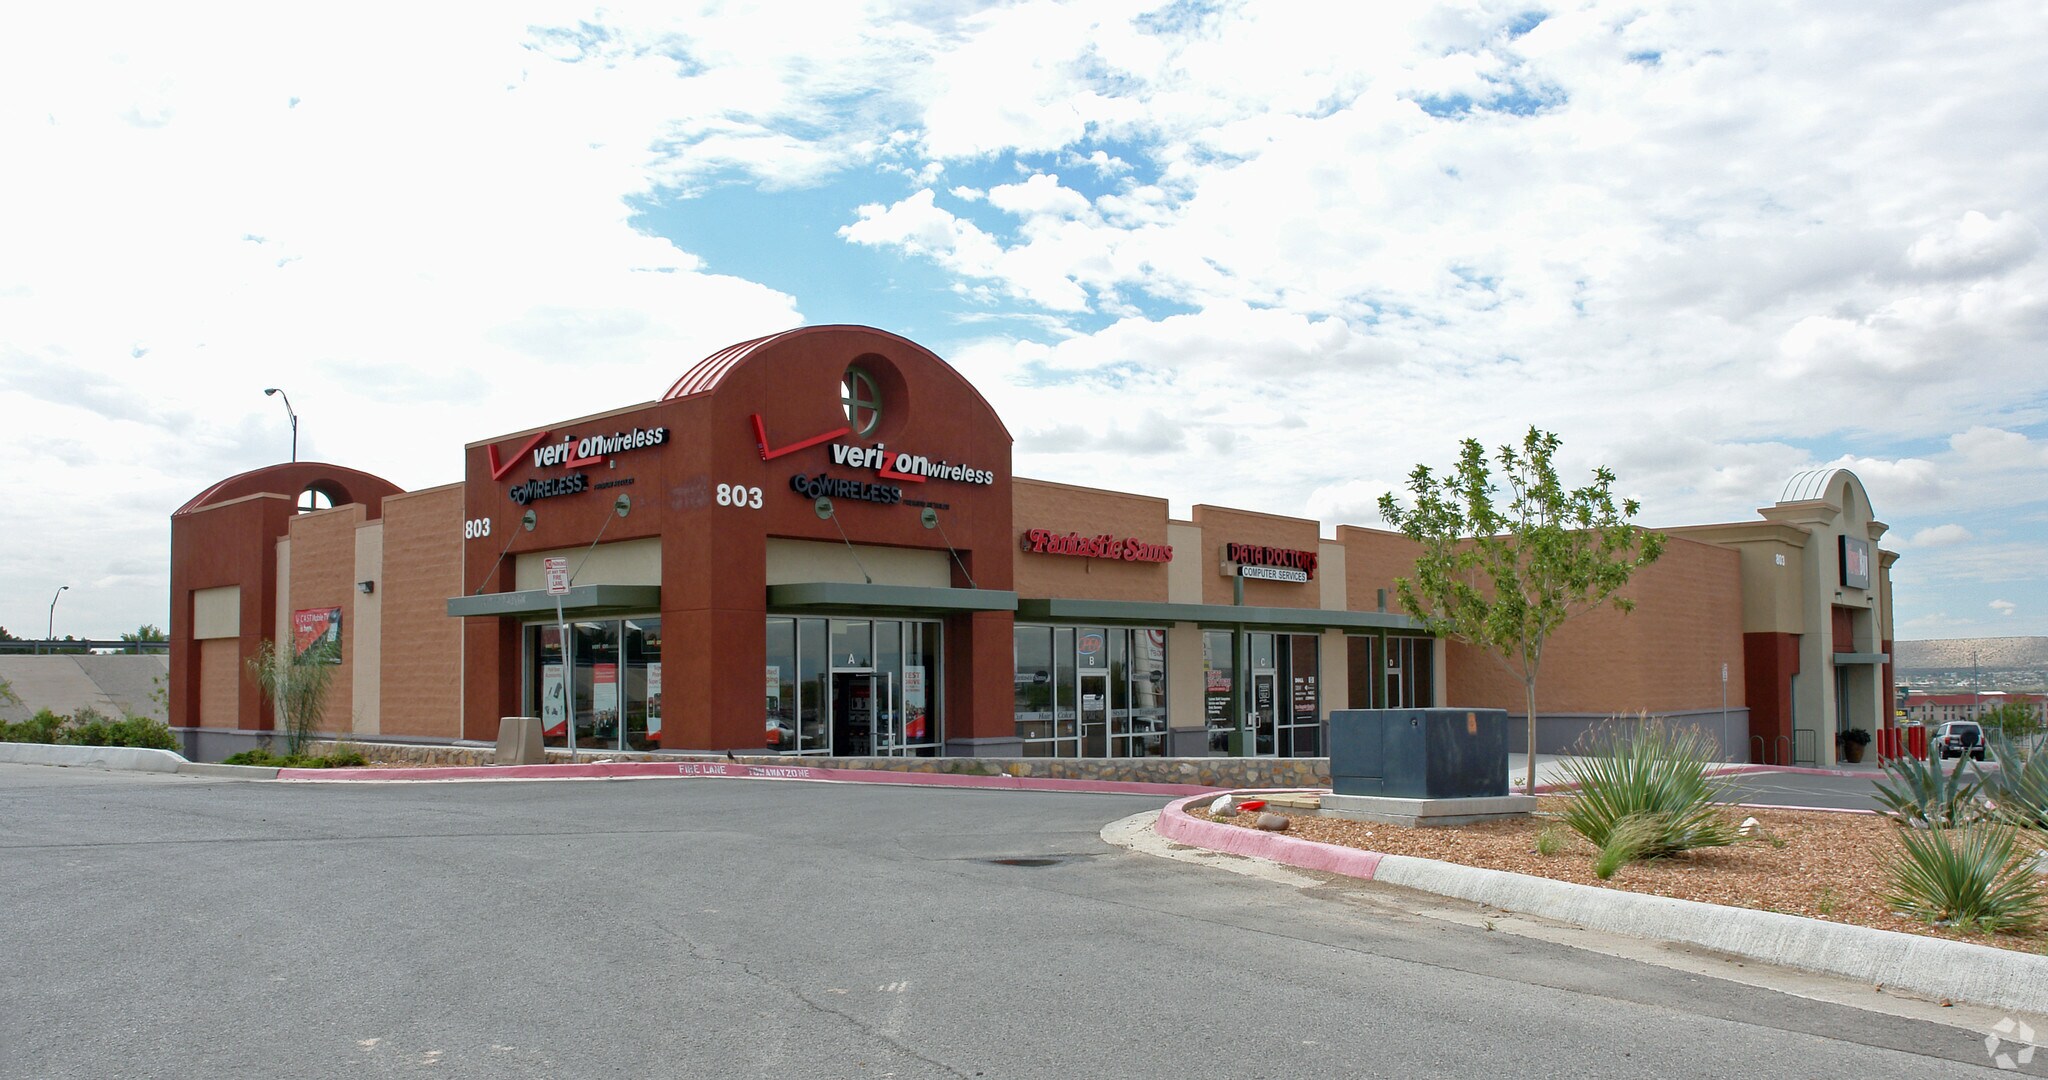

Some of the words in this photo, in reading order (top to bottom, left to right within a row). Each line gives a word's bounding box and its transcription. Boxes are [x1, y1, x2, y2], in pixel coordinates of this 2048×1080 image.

[716, 483, 763, 509] 803
[465, 517, 491, 539] 803
[1028, 528, 1121, 559] Fantastic
[1122, 537, 1174, 563] Sams
[1230, 543, 1263, 565] DATA
[1265, 546, 1318, 570] DOCTORS
[1775, 553, 1785, 566] 803
[1243, 566, 1277, 579] COMPUTER
[1278, 569, 1306, 582] SERVICES
[848, 653, 855, 665] A
[1089, 656, 1095, 665] B
[1261, 657, 1266, 666] C
[679, 764, 700, 774] FIRE
[703, 765, 727, 775] LANE
[765, 769, 786, 777] AWAY
[786, 769, 810, 778] ZONE
